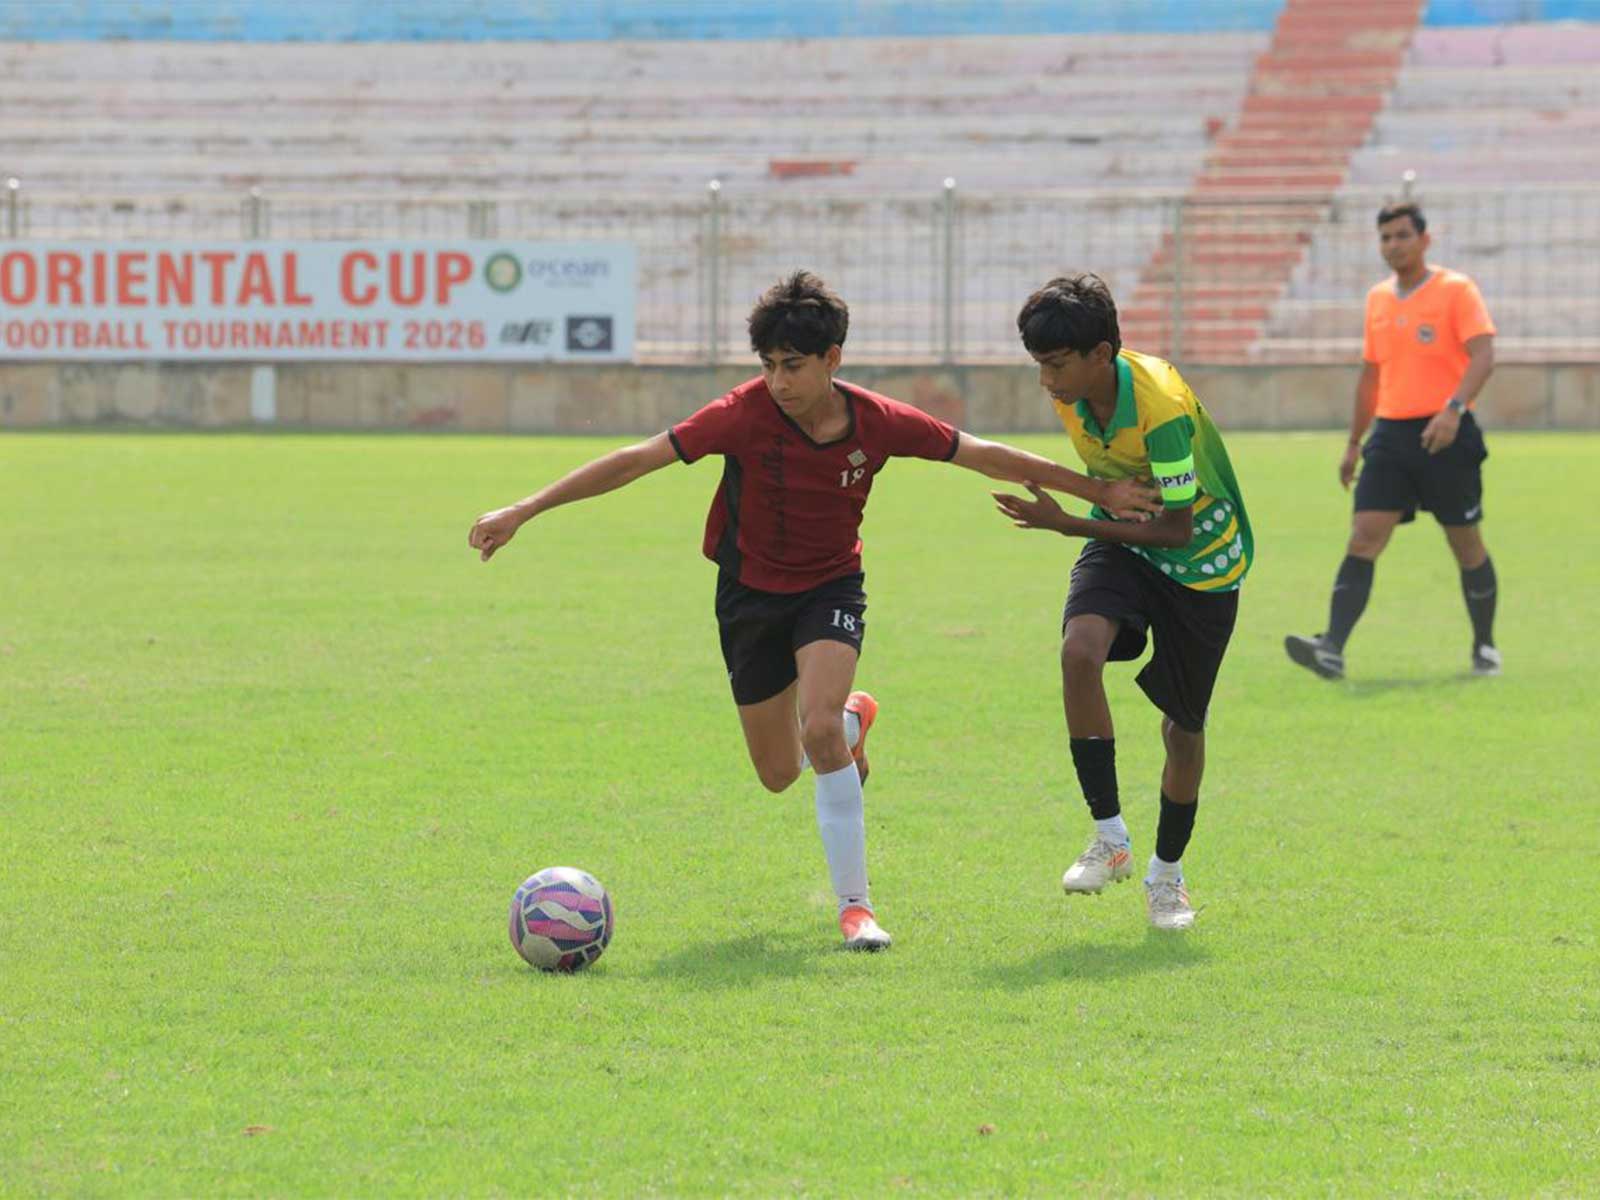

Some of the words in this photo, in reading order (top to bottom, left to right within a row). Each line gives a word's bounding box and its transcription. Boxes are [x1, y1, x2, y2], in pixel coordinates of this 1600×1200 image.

[0, 251, 312, 306] ORIENTAL
[340, 251, 474, 307] CUP
[0, 320, 148, 348] OOTBALL
[163, 320, 388, 349] TOURNAMENT
[403, 320, 486, 350] 2026
[831, 608, 857, 632] 18
